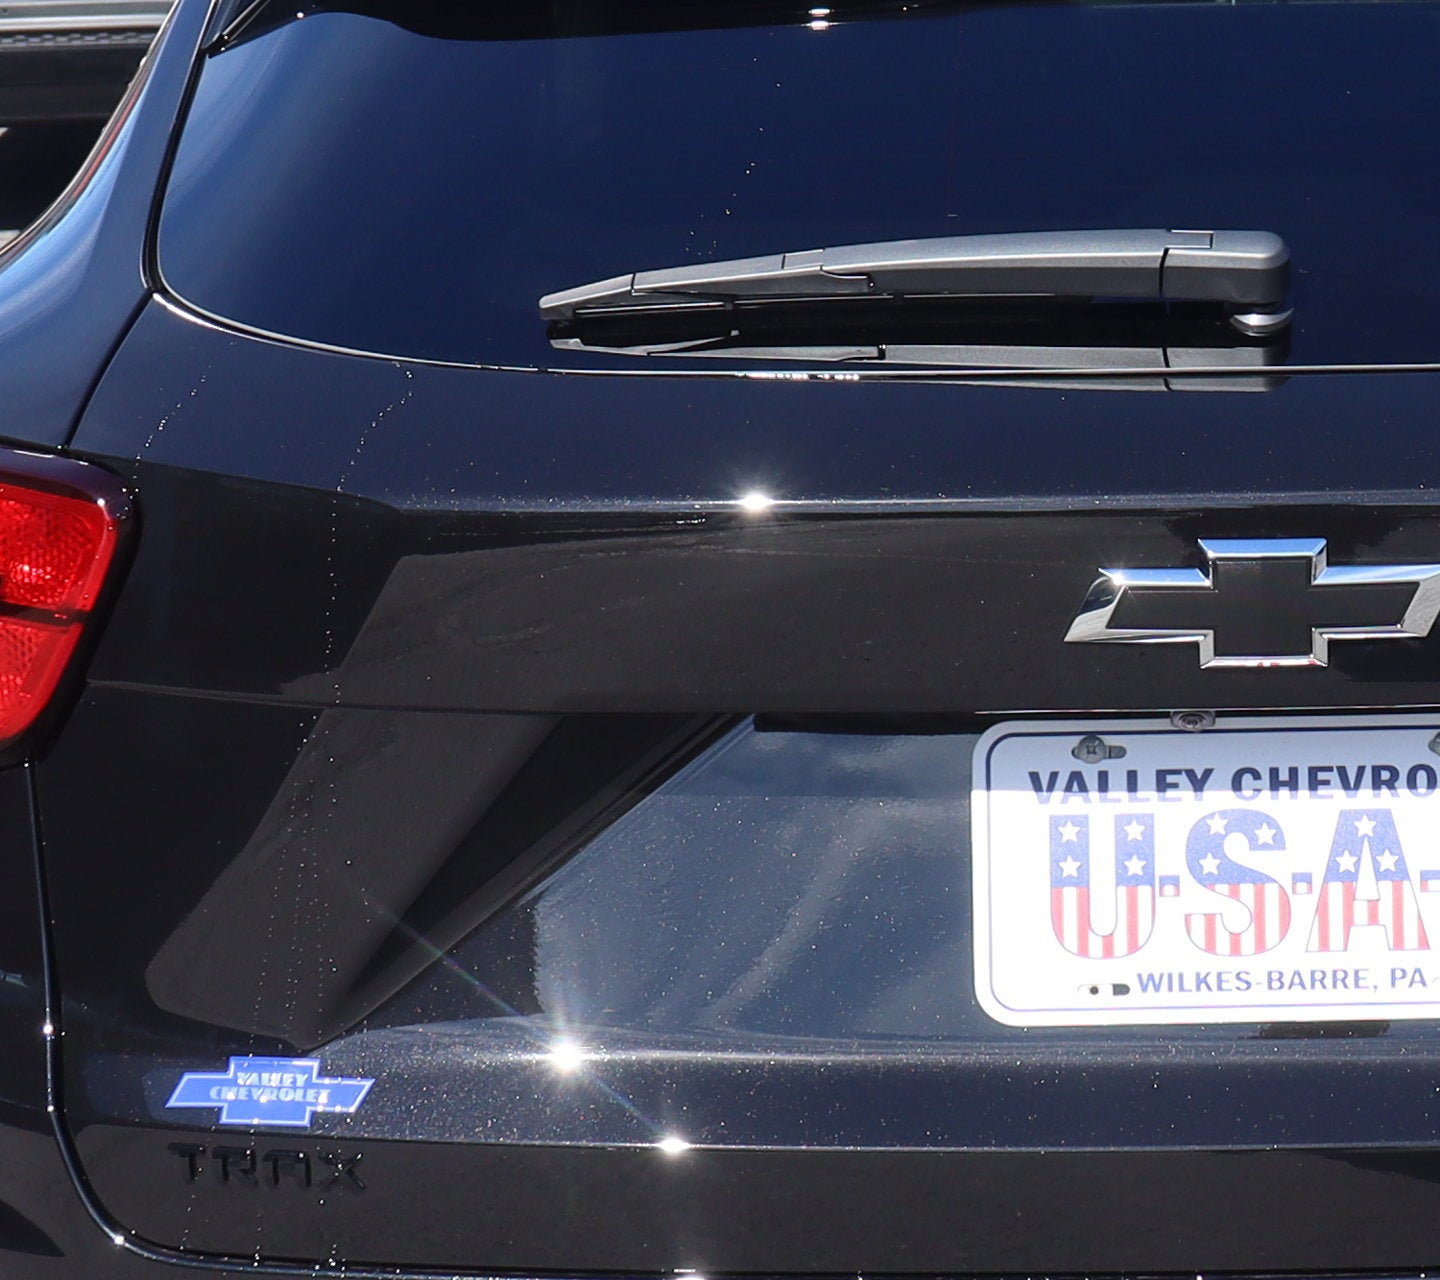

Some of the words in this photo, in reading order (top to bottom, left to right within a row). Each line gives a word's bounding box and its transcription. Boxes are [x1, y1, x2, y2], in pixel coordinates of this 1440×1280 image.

[1026, 767, 1215, 806] VALLEY
[1136, 968, 1381, 995] WILKES-BARRE,
[1390, 967, 1429, 991] PA
[236, 1071, 310, 1087] VALLEY
[209, 1086, 332, 1104] CHEVROLET
[167, 1142, 367, 1189] TRAX
